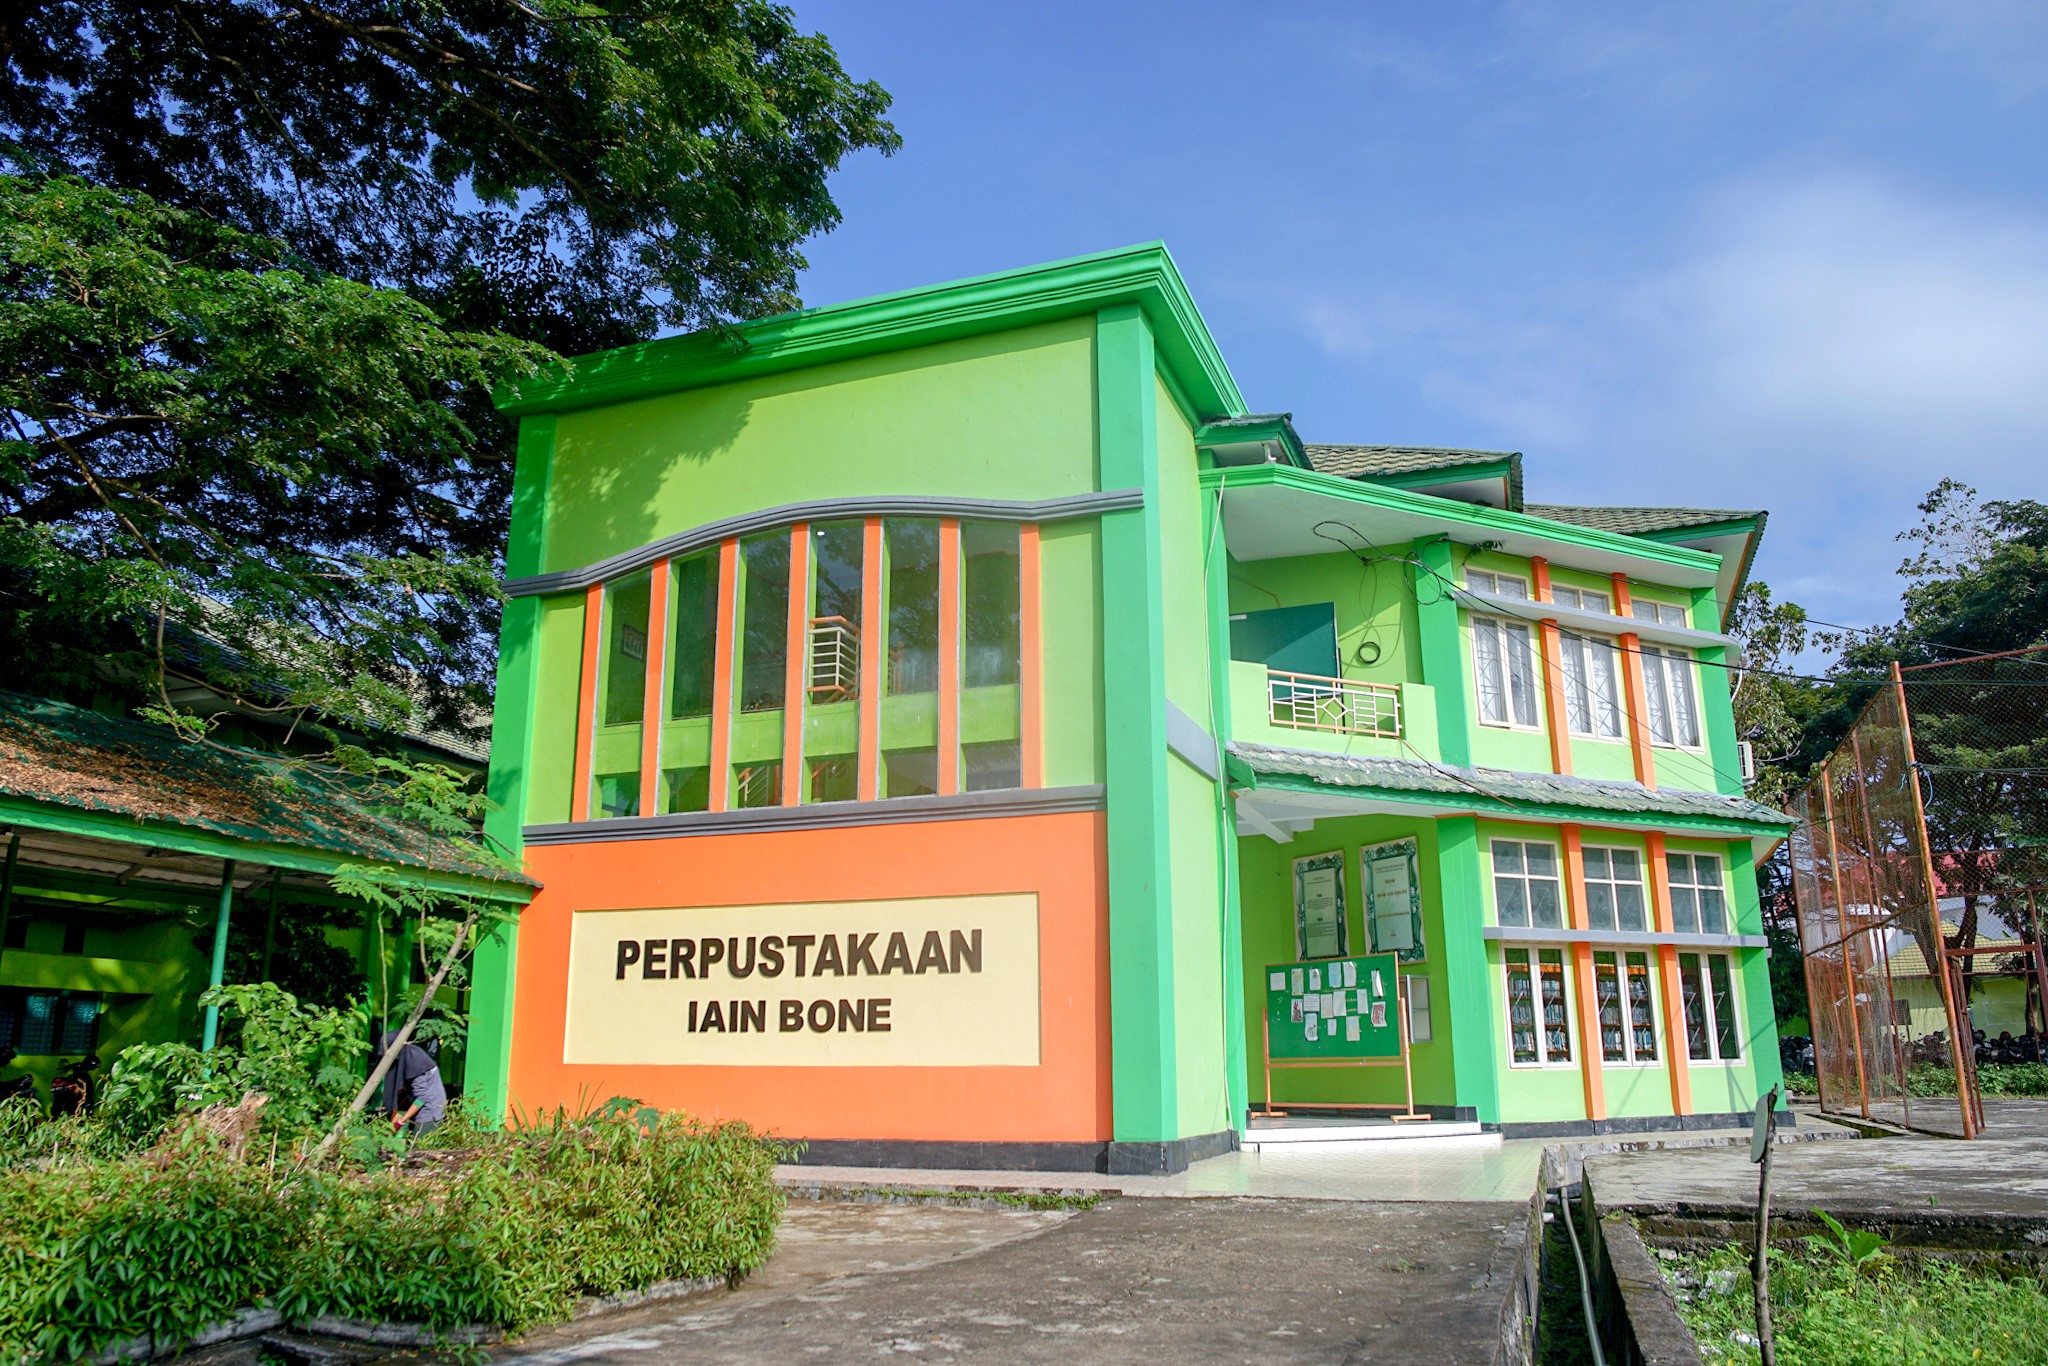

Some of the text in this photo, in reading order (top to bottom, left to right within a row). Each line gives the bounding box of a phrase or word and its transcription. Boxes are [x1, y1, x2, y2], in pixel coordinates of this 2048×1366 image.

[616, 929, 982, 980] PERPUSTAKAAN
[688, 998, 891, 1033] IAIN BONE
